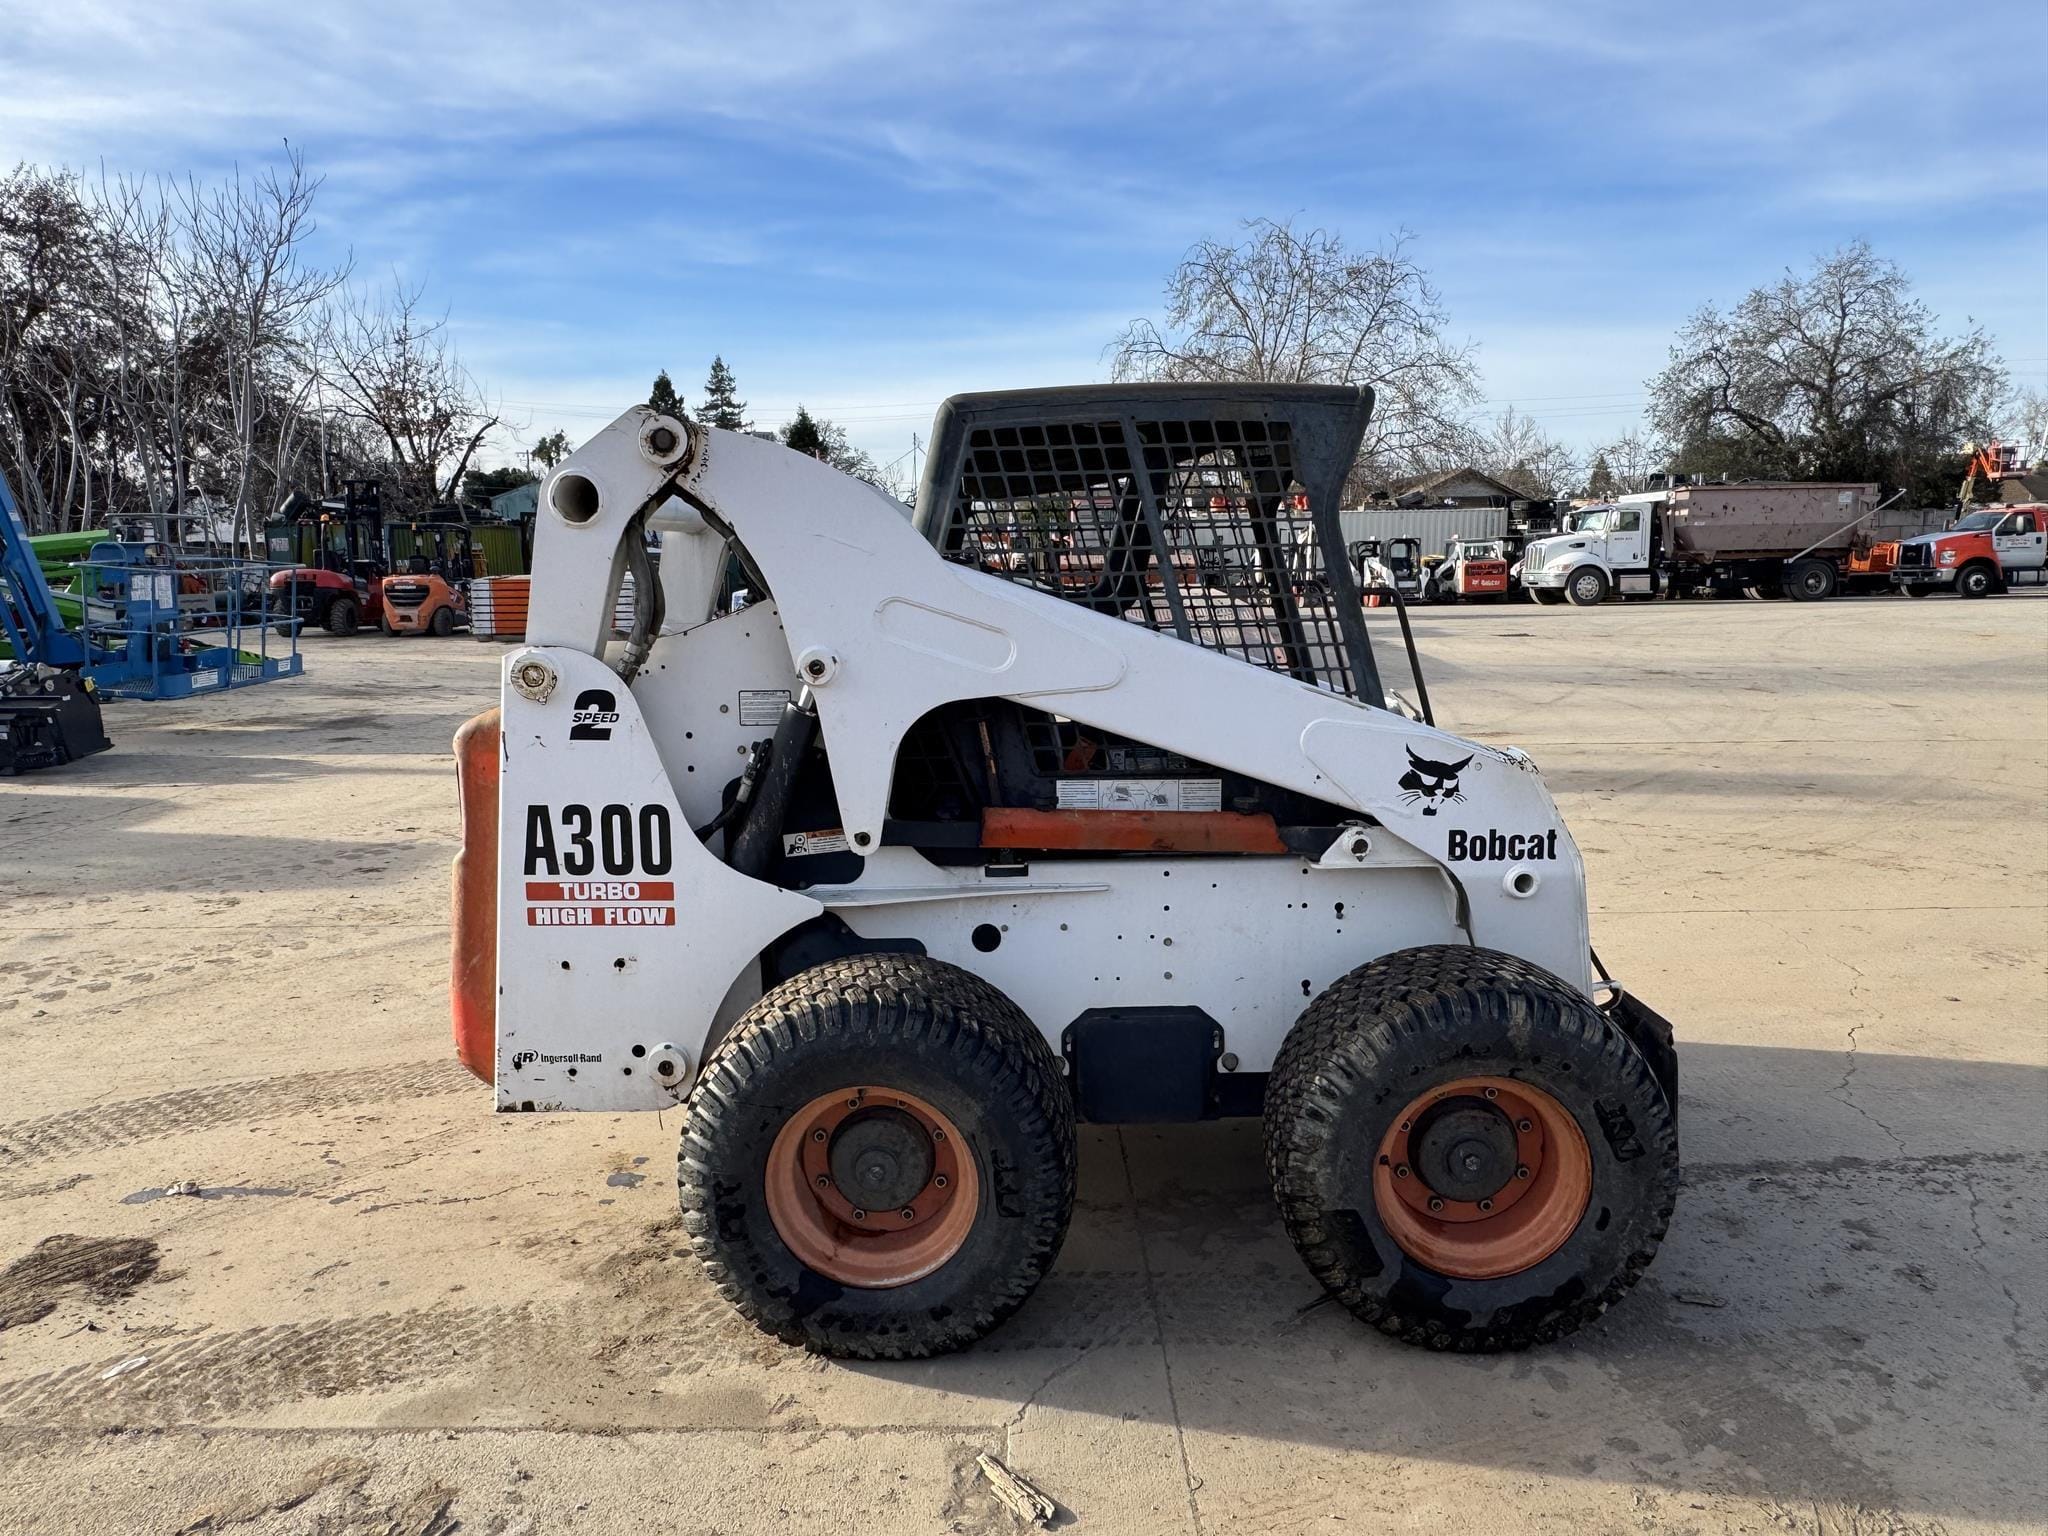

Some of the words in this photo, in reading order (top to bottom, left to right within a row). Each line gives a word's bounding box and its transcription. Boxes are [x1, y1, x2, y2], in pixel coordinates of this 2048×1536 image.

[570, 689, 617, 740] 2
[573, 712, 620, 723] SPEED
[524, 804, 672, 876] A300
[1448, 829, 1557, 861] Bobcat
[559, 883, 641, 900] TURBO
[536, 908, 592, 925] HIGH
[604, 908, 667, 925] FLOW
